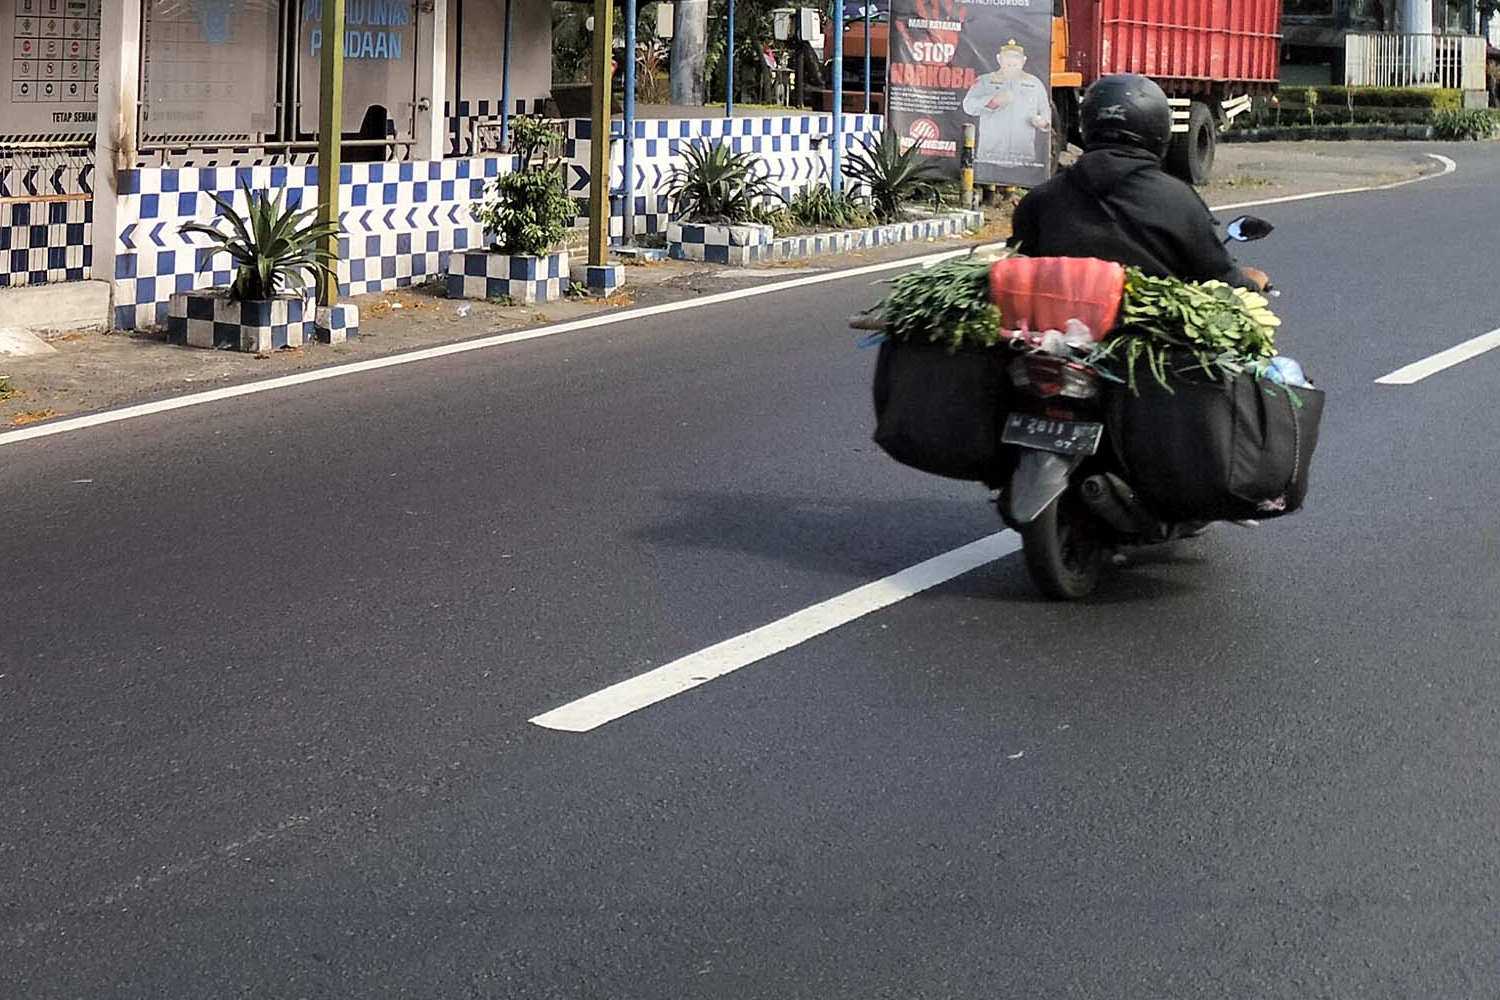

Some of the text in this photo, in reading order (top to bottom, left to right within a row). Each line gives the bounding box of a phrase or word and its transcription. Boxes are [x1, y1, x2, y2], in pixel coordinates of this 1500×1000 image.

[310, 28, 403, 59] PDAAN
[912, 40, 955, 63] STOP
[890, 62, 977, 89] NARKOBA
[52, 111, 73, 124] TETAP
